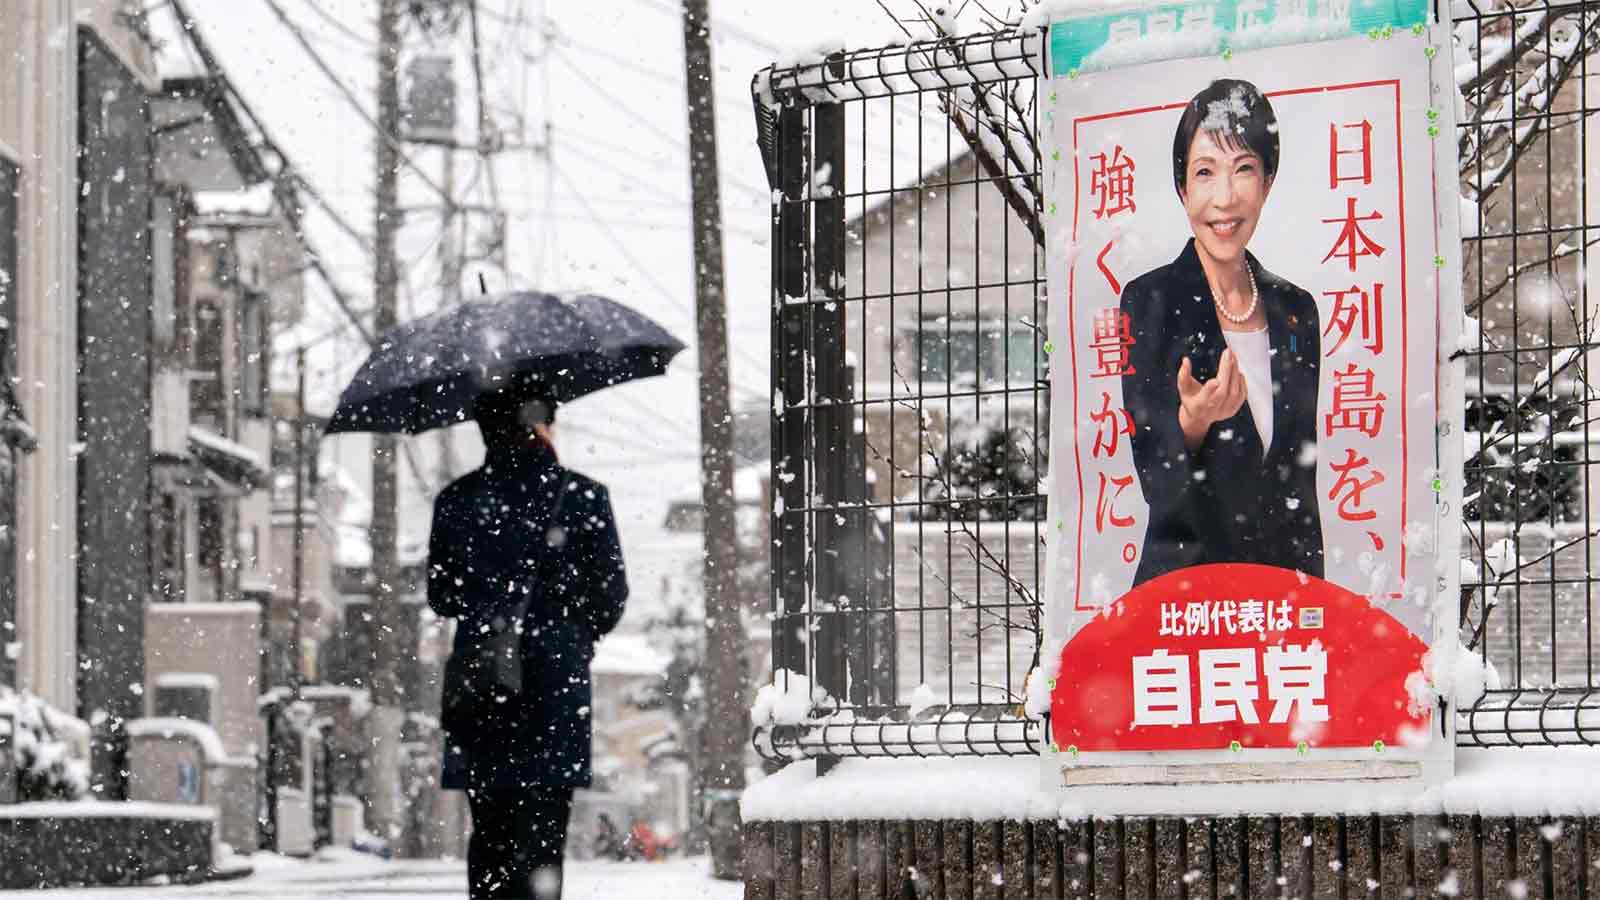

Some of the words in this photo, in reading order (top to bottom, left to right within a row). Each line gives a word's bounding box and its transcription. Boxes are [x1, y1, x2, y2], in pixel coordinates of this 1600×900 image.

[1088, 144, 1137, 564] 強く豊かに。
[1320, 118, 1387, 551] 日本列島を、
[1132, 644, 1329, 725] 自民党
[1159, 599, 1293, 636] 比例代表は
